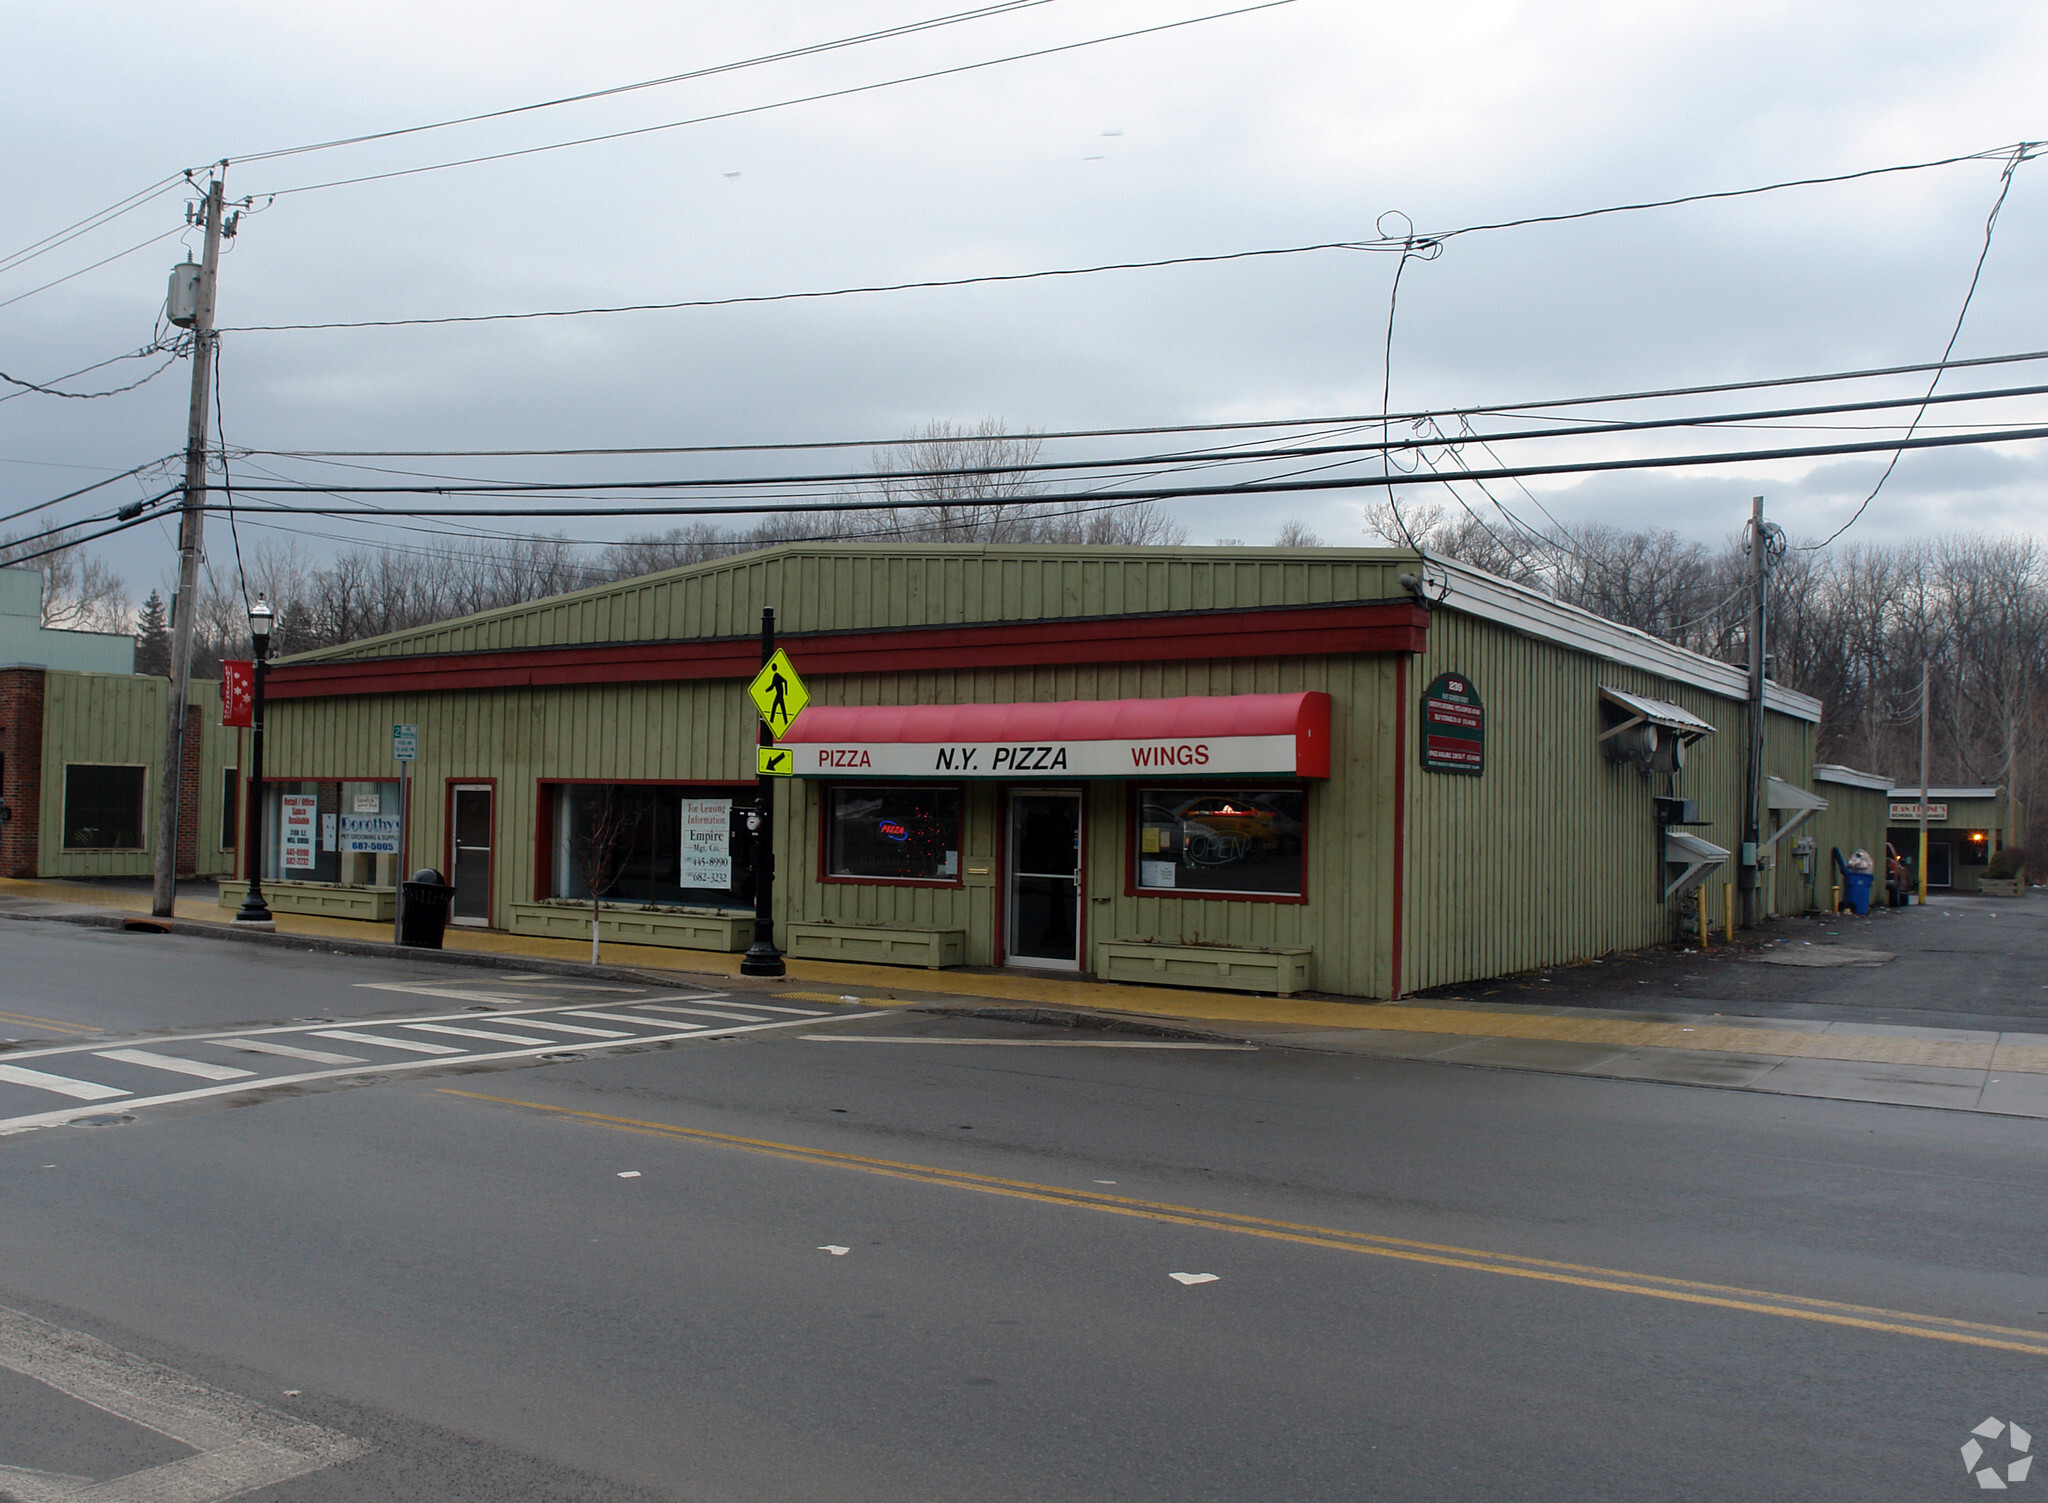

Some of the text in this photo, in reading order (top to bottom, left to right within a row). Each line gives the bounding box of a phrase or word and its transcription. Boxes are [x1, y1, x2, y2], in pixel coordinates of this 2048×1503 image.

[1448, 681, 1463, 692] 239
[394, 726, 400, 737] 2
[819, 750, 871, 767] PIZZA
[935, 747, 1067, 770] N.Y. PIZZA
[1131, 744, 1209, 767] WINGS
[688, 802, 726, 815] For Leasing
[687, 814, 726, 825] Information
[881, 824, 905, 834] PIZZA
[690, 829, 724, 844] Empire
[352, 842, 394, 851] 687-5005
[693, 844, 720, 853] Mgt. Co.
[1192, 835, 1247, 858] OPEN
[693, 857, 728, 867] 445-8990
[693, 872, 727, 883] 682-3232
